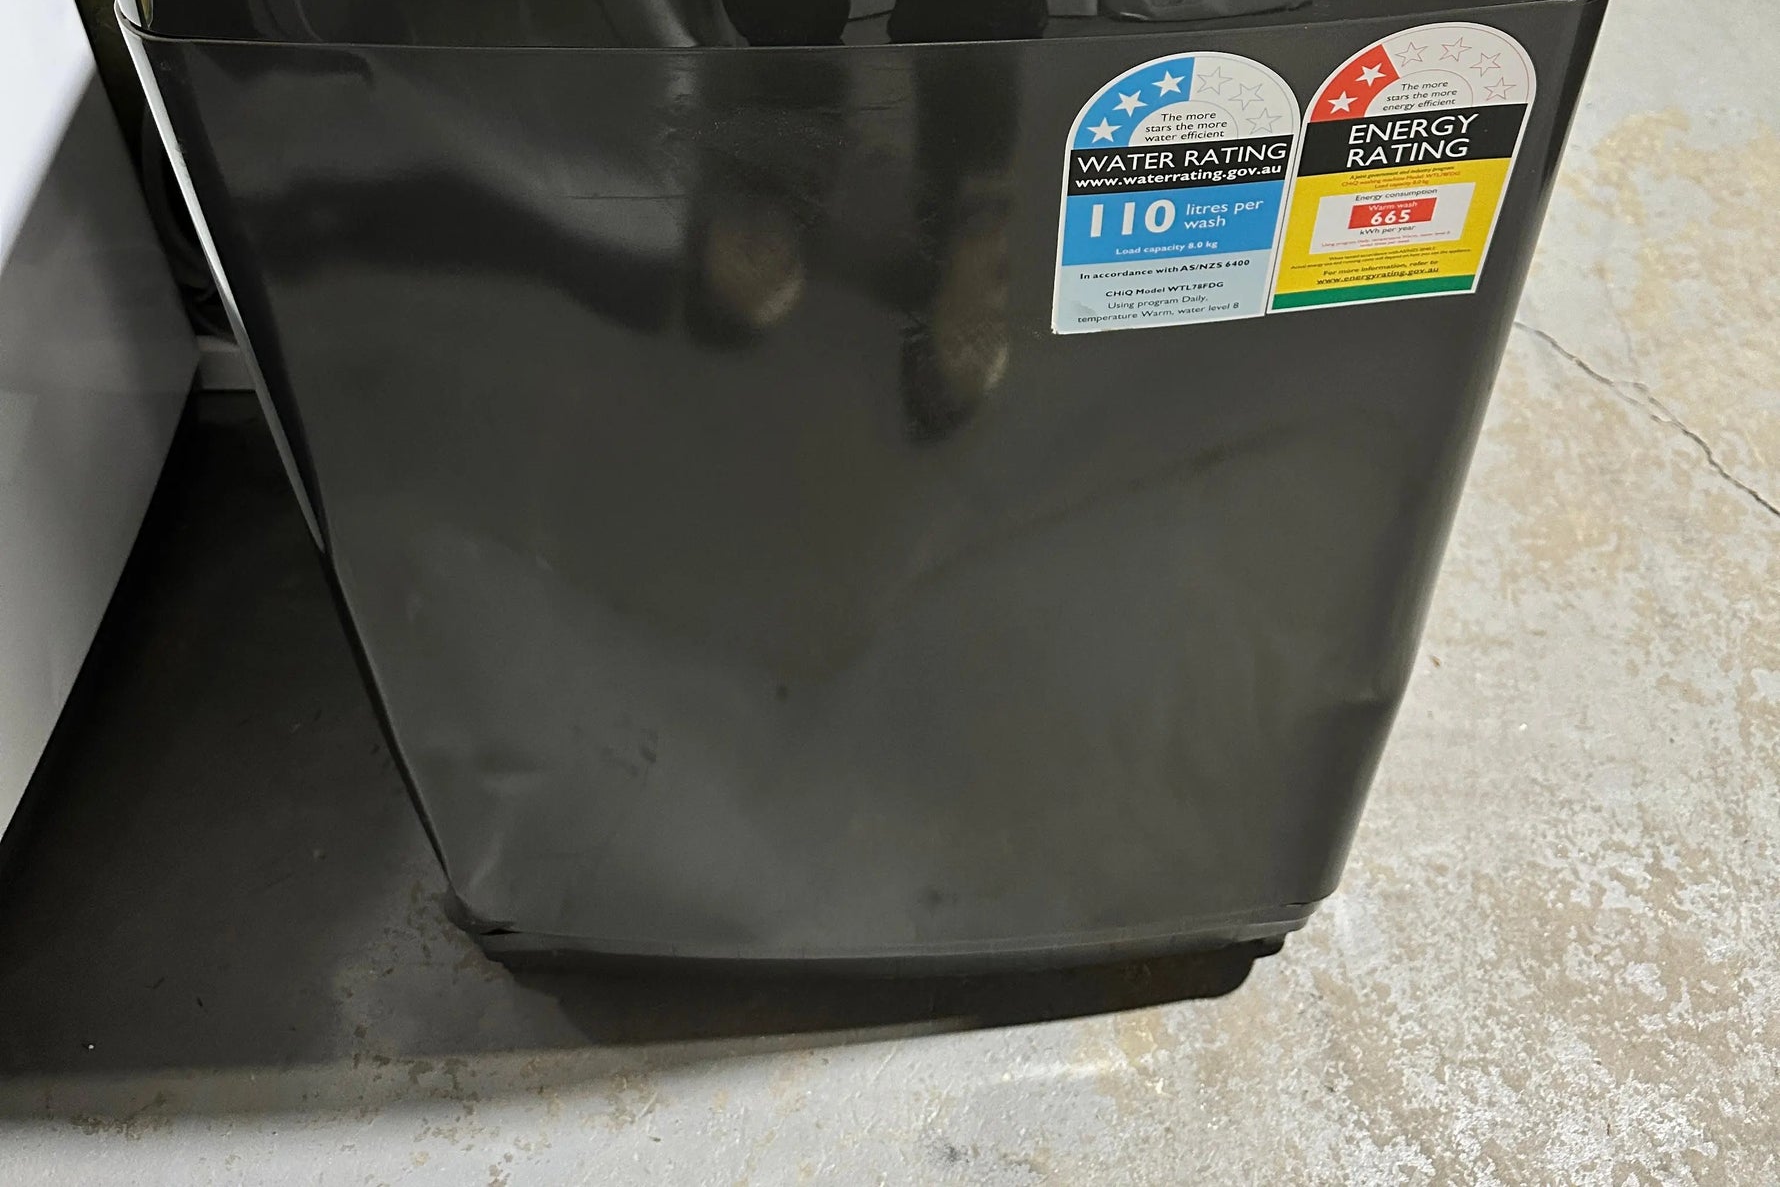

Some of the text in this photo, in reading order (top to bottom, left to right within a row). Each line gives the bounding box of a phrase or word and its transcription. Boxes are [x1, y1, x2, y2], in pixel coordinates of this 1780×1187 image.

[1401, 81, 1448, 92] The more
[1386, 89, 1458, 102] stars the more
[1382, 98, 1456, 112] energy efficient
[1161, 112, 1217, 122] The more
[1145, 120, 1228, 133] stars the more
[1348, 113, 1480, 145] ENERGY
[1144, 130, 1225, 142] water efficient
[1077, 142, 1288, 174] WATER RATING
[1346, 138, 1471, 168] RATING
[1075, 165, 1282, 188] www.waterrating.gov.au
[1355, 188, 1438, 202] Energy consumption
[1368, 201, 1418, 212] Warm wash
[1090, 199, 1264, 238] 110 litres per
[1184, 215, 1226, 230] wash
[1370, 209, 1412, 226] 665
[1381, 226, 1395, 234] per
[1398, 224, 1416, 233] year
[1115, 246, 1141, 255] Load
[1143, 244, 1186, 255] capacity
[1206, 240, 1218, 249] kg
[1092, 268, 1153, 279] accordance
[1156, 266, 1179, 274] with
[1179, 262, 1223, 273] AS/NZS
[1225, 259, 1250, 268] 6400
[1409, 259, 1429, 267] refer
[1316, 267, 1439, 286] www.energyrating.gov.au
[1136, 287, 1165, 295] Model
[1168, 281, 1224, 293] WTL78FDG
[1108, 300, 1134, 311] Using
[1137, 298, 1179, 308] program
[1077, 302, 1240, 324] temperature Warm, water level 8
